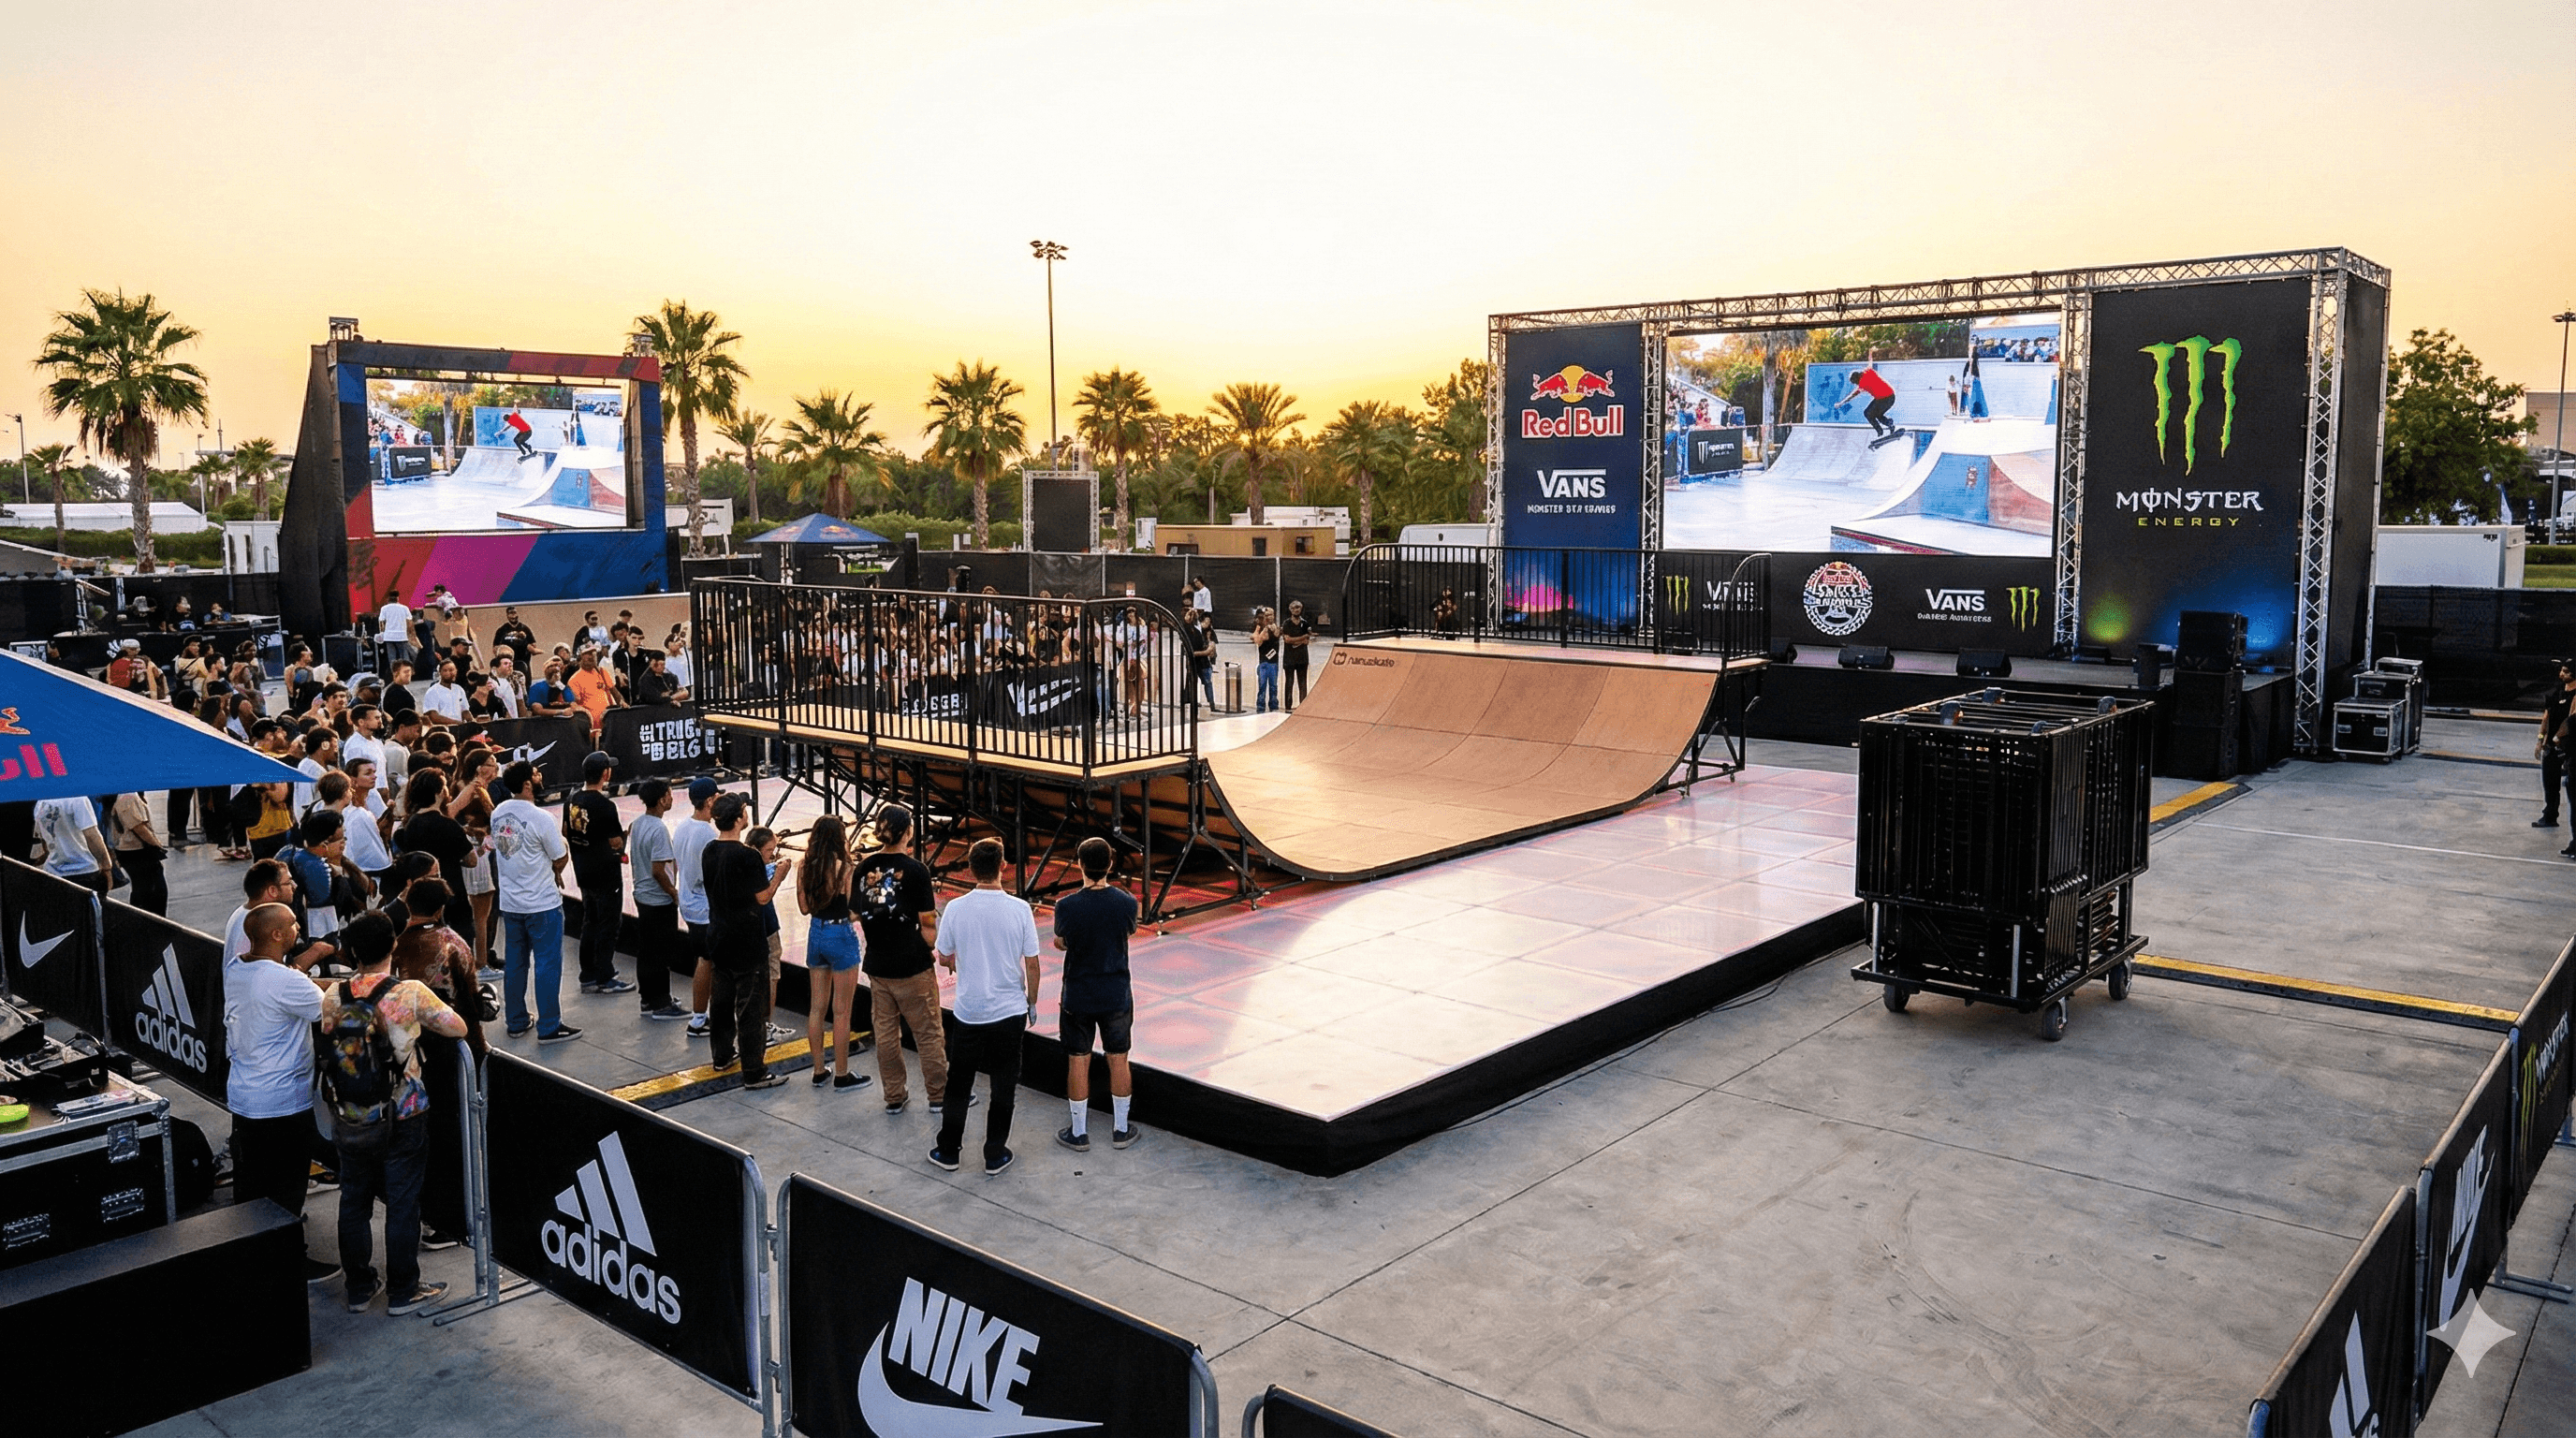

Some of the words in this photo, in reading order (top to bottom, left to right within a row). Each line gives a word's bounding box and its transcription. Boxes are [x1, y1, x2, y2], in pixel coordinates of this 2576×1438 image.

[1522, 406, 1572, 438] Red
[1573, 404, 1624, 437] Bull
[1537, 469, 1606, 498] VANS
[2115, 487, 2264, 513] MONSTER
[2138, 517, 2239, 526] ENERGY
[1925, 588, 1985, 611] VANS
[135, 1011, 208, 1074] adidas
[541, 1219, 681, 1325] adidas
[888, 1276, 1040, 1416] NIKE
